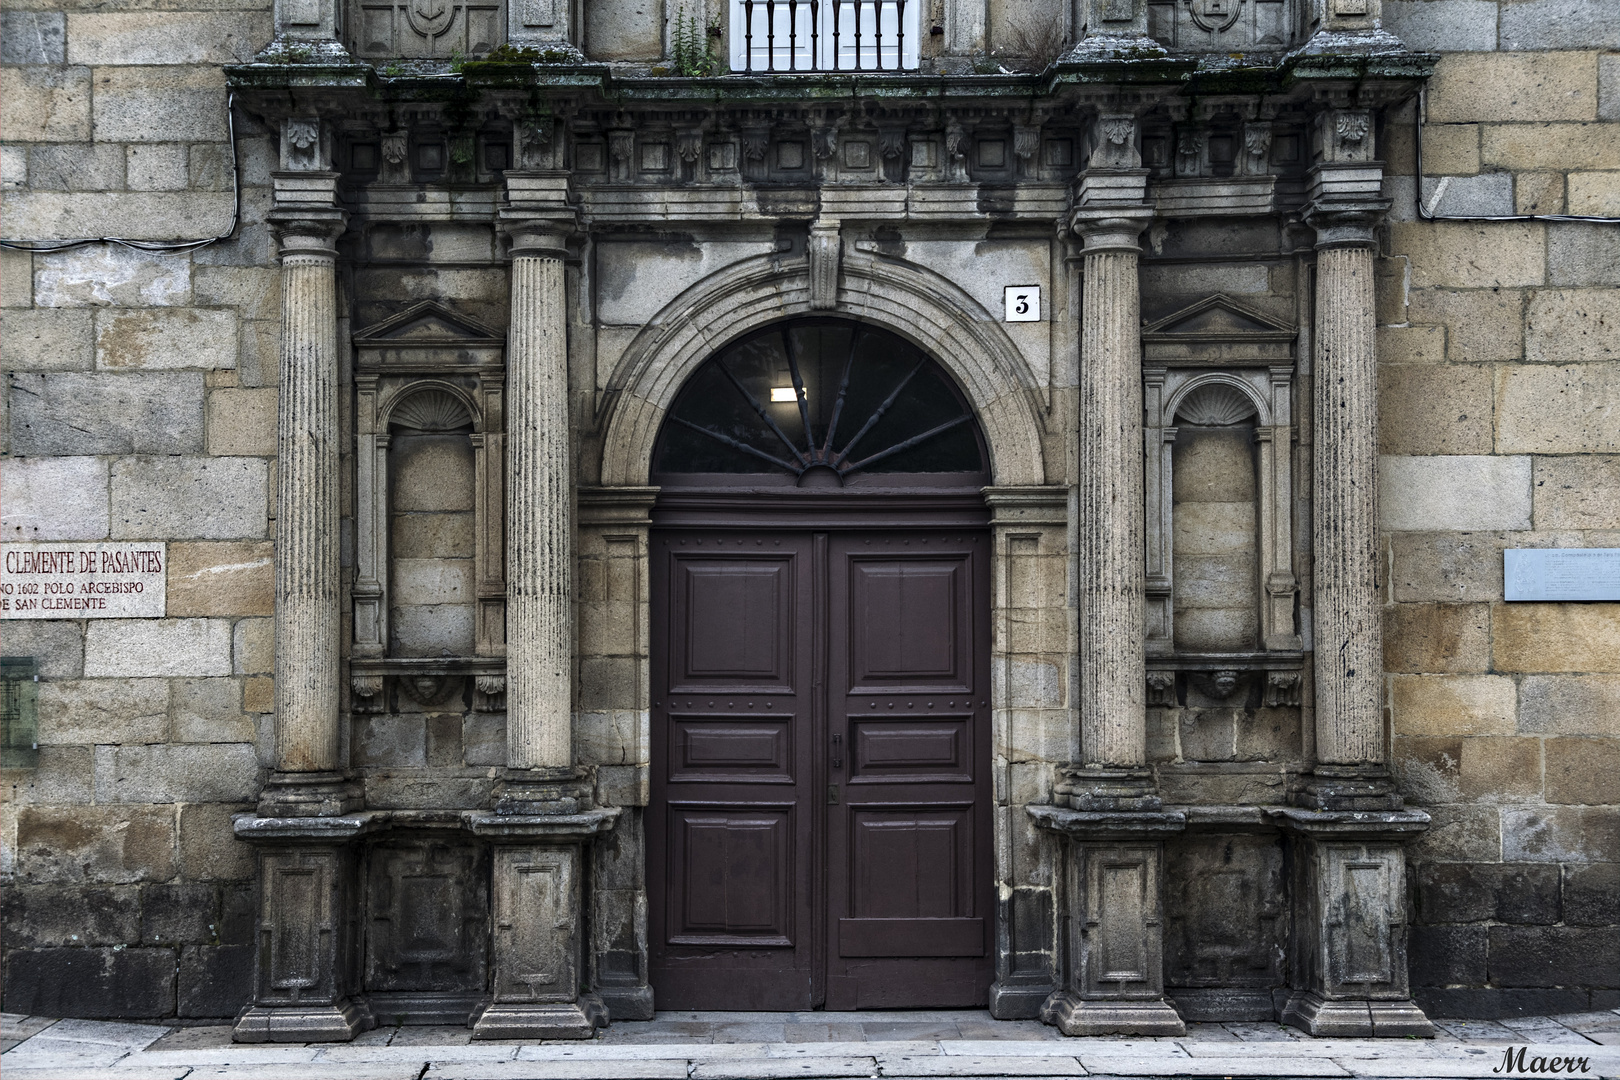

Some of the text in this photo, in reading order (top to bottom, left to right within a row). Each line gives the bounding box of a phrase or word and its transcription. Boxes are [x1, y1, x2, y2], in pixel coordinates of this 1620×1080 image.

[1015, 294, 1029, 315] 3
[6, 551, 162, 574] CLEMENTE DE PASANTES
[17, 583, 39, 595] 1602
[44, 582, 75, 594] POLO
[80, 581, 144, 594] ARCEBISPO
[0, 597, 107, 611] E SAN CLEMENTE
